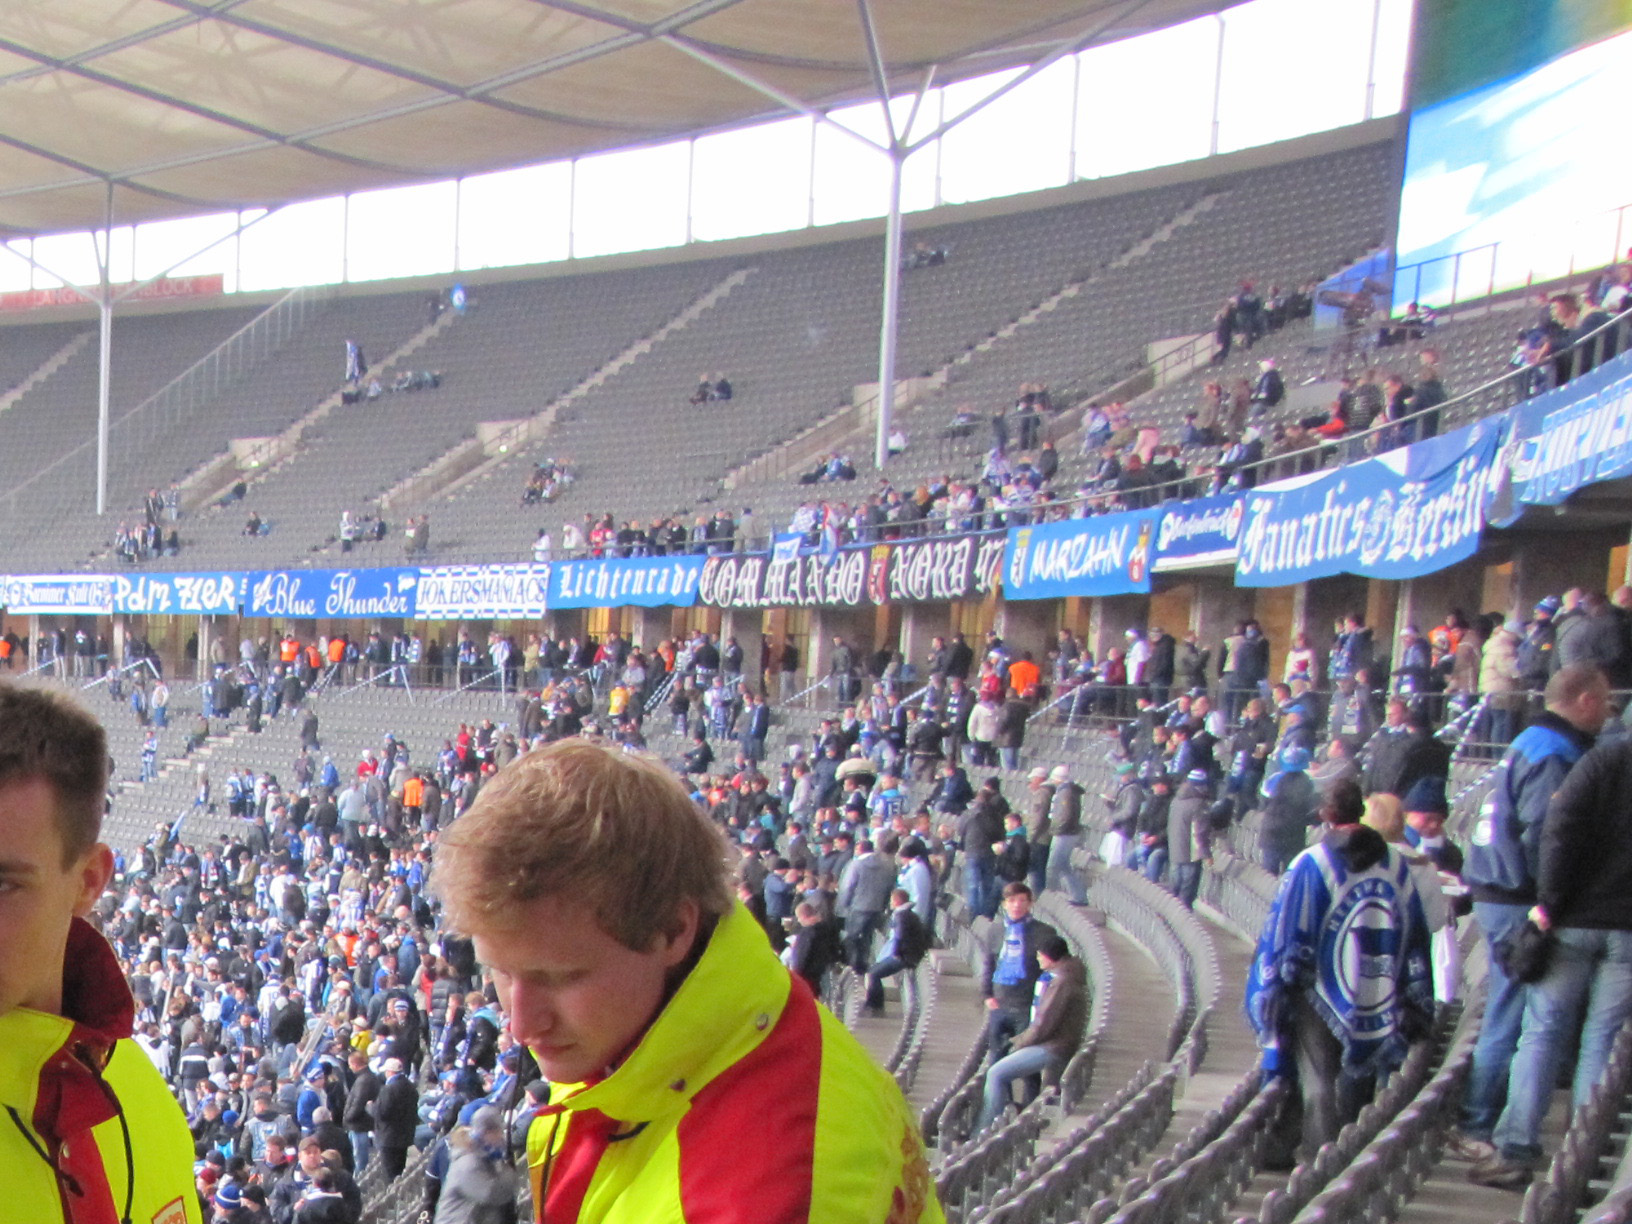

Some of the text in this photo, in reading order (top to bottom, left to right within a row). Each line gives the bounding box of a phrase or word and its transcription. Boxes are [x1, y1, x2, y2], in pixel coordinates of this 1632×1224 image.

[890, 537, 971, 600] NORD
[1029, 524, 1128, 583] MARZAHN
[267, 573, 316, 616] Blue
[325, 572, 409, 616] Thunder
[558, 562, 698, 600] Lichtenrade
